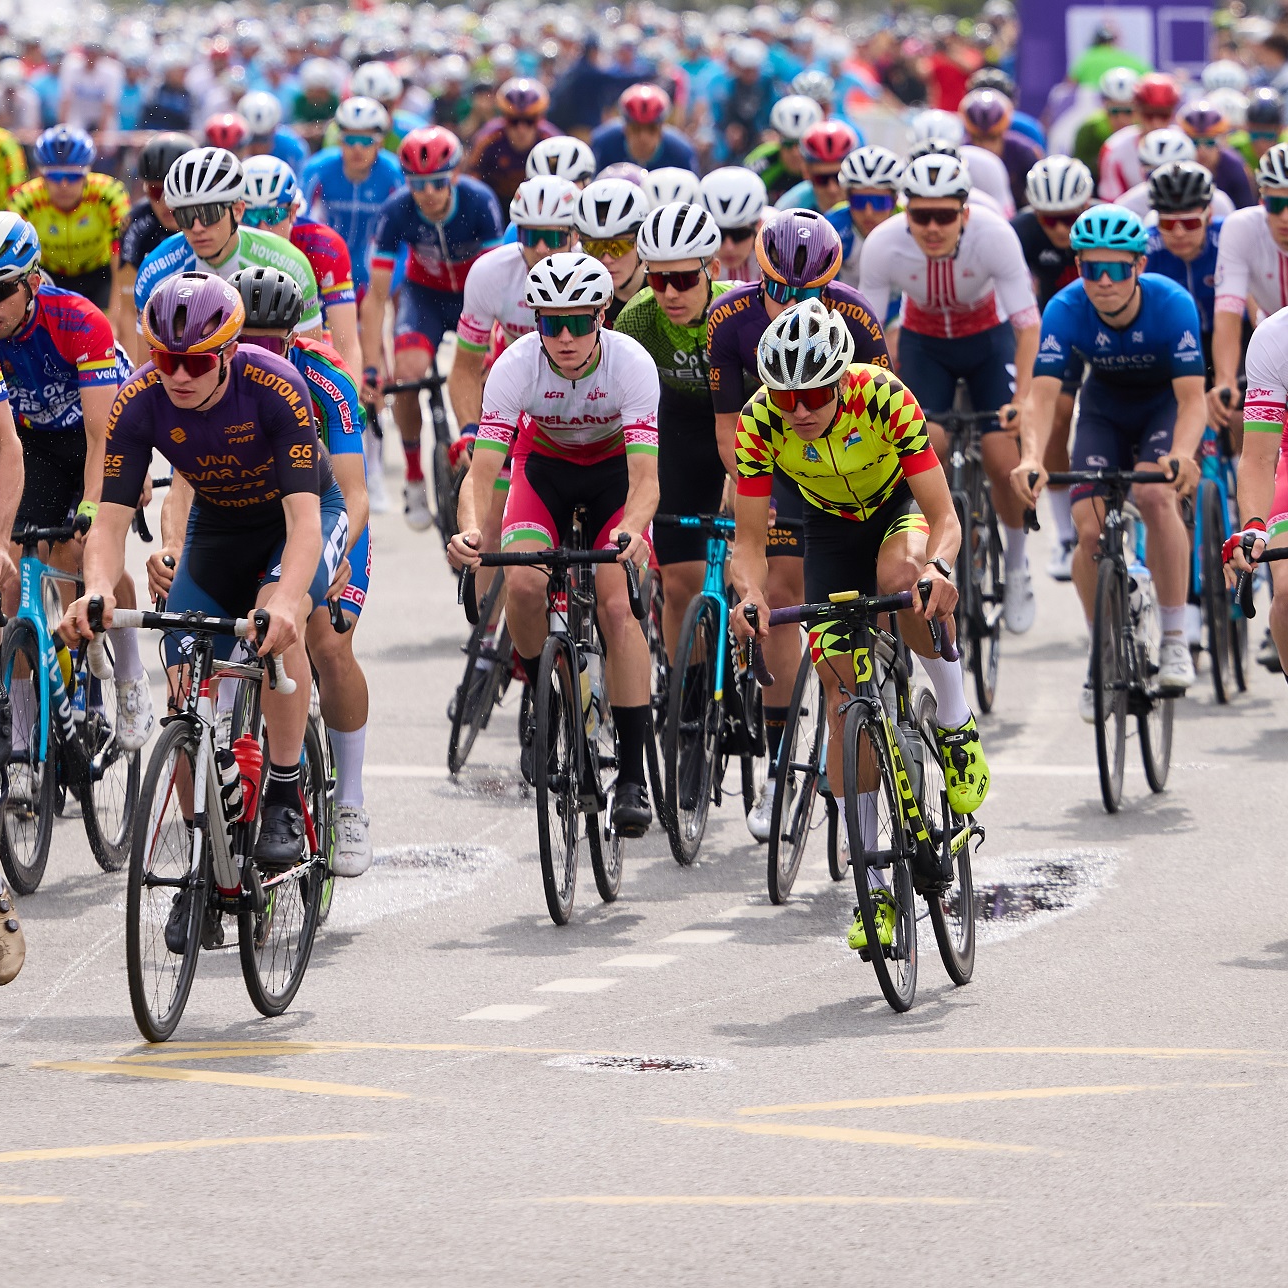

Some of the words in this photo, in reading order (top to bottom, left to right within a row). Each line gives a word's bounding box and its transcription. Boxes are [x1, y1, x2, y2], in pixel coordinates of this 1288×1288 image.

[135, 245, 189, 297] NOVOSIBIRSK
[250, 242, 311, 289] NOVOSIBIRSK
[243, 363, 311, 428] PELOTON.BY
[305, 365, 344, 402] MOSCOW
[531, 412, 622, 426] BELARUS
[180, 468, 235, 482] OVAR
[21, 563, 31, 608] FACTOR
[189, 651, 204, 708] LOOK
